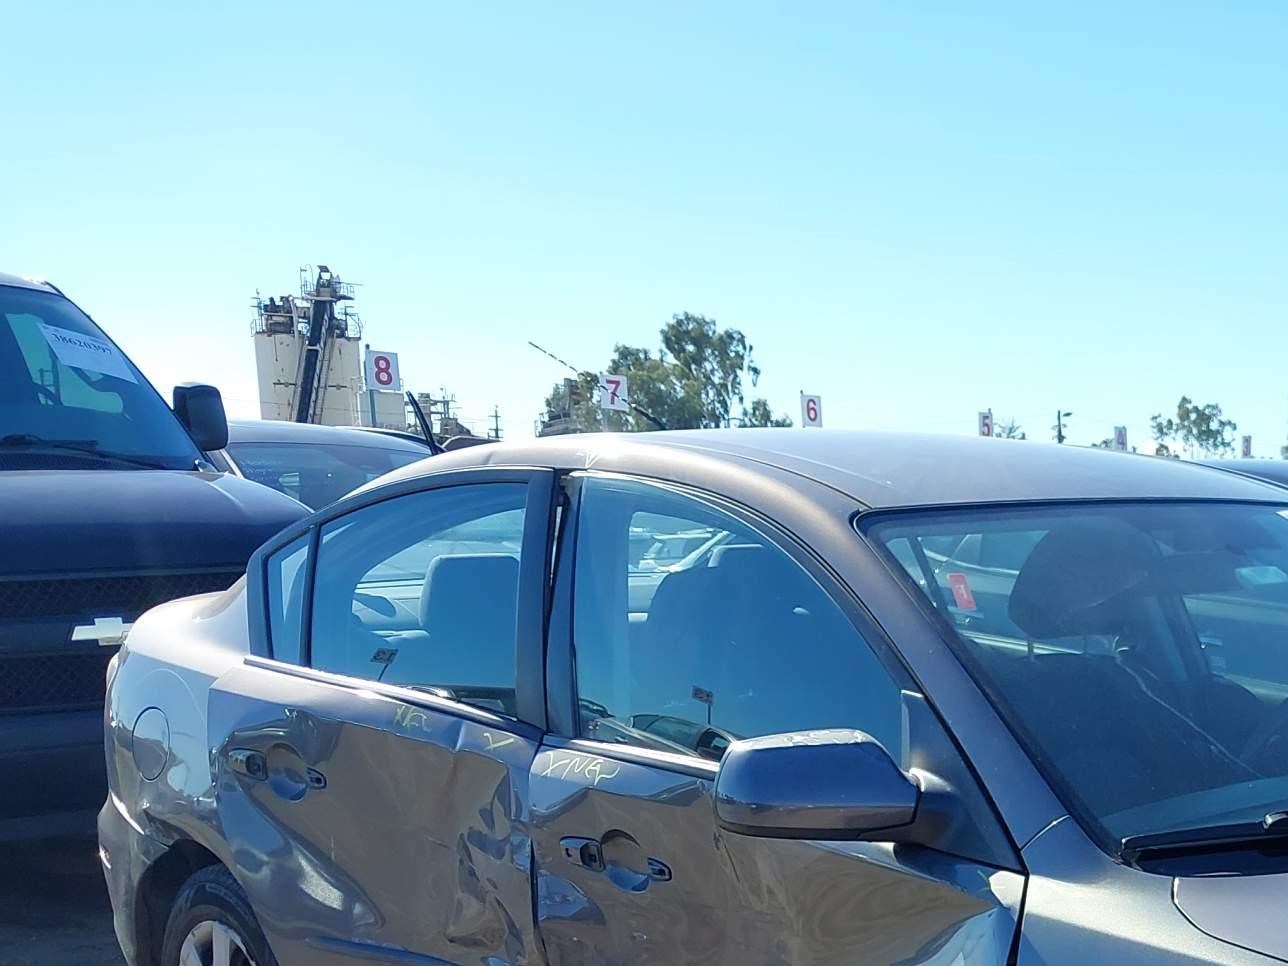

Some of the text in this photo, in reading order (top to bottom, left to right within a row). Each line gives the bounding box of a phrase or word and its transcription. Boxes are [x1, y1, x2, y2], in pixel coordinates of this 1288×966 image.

[374, 356, 393, 385] 8
[606, 378, 620, 405] 7
[806, 398, 818, 422] 6
[982, 415, 991, 436] 5
